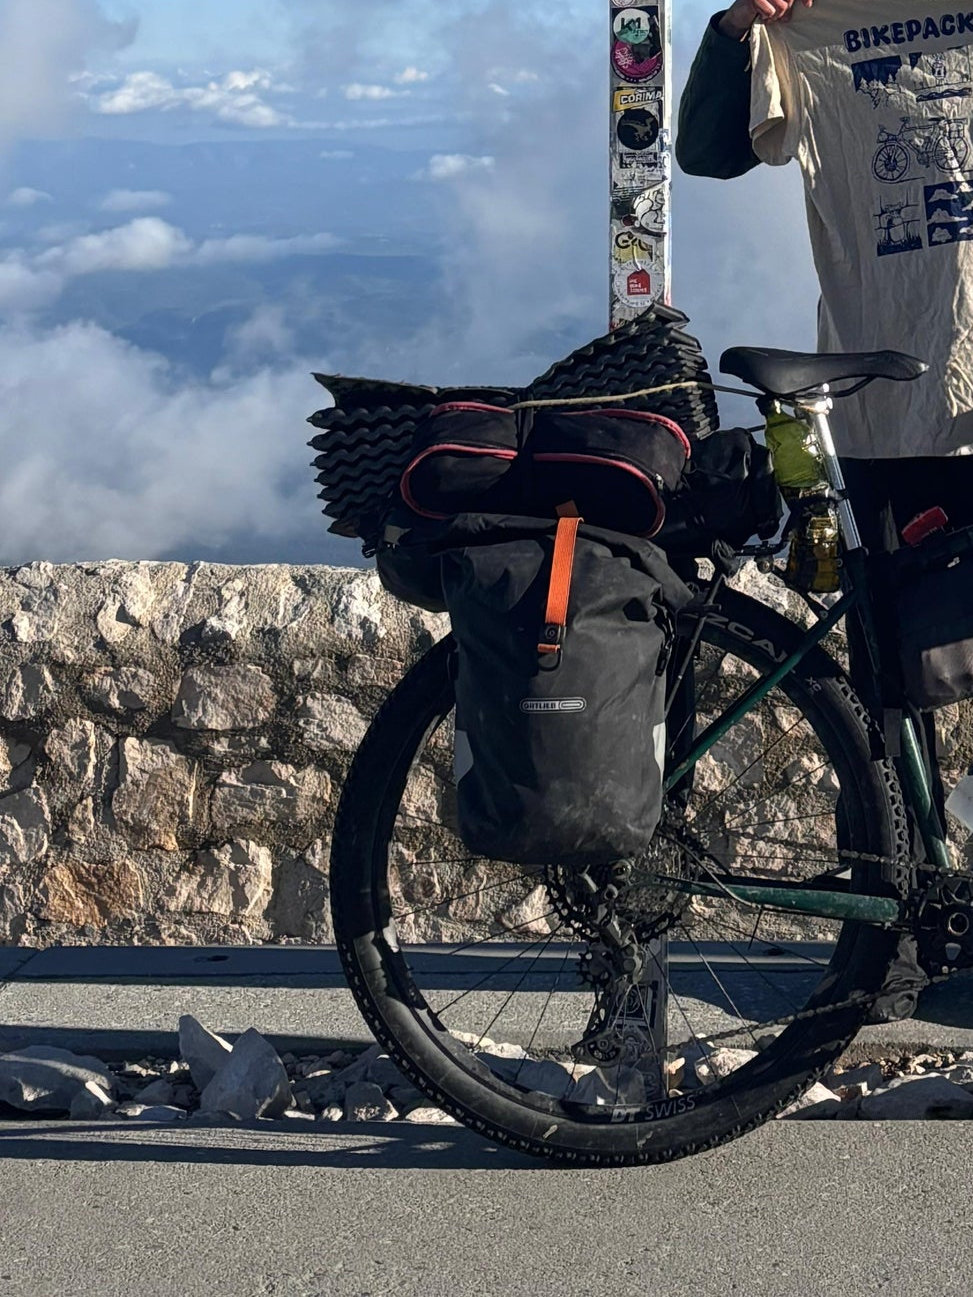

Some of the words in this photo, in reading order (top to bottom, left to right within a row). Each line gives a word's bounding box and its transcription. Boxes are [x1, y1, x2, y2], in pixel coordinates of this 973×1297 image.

[620, 90, 663, 105] CORIMA
[611, 1107, 641, 1123] DT
[644, 1094, 697, 1121] SWISS
